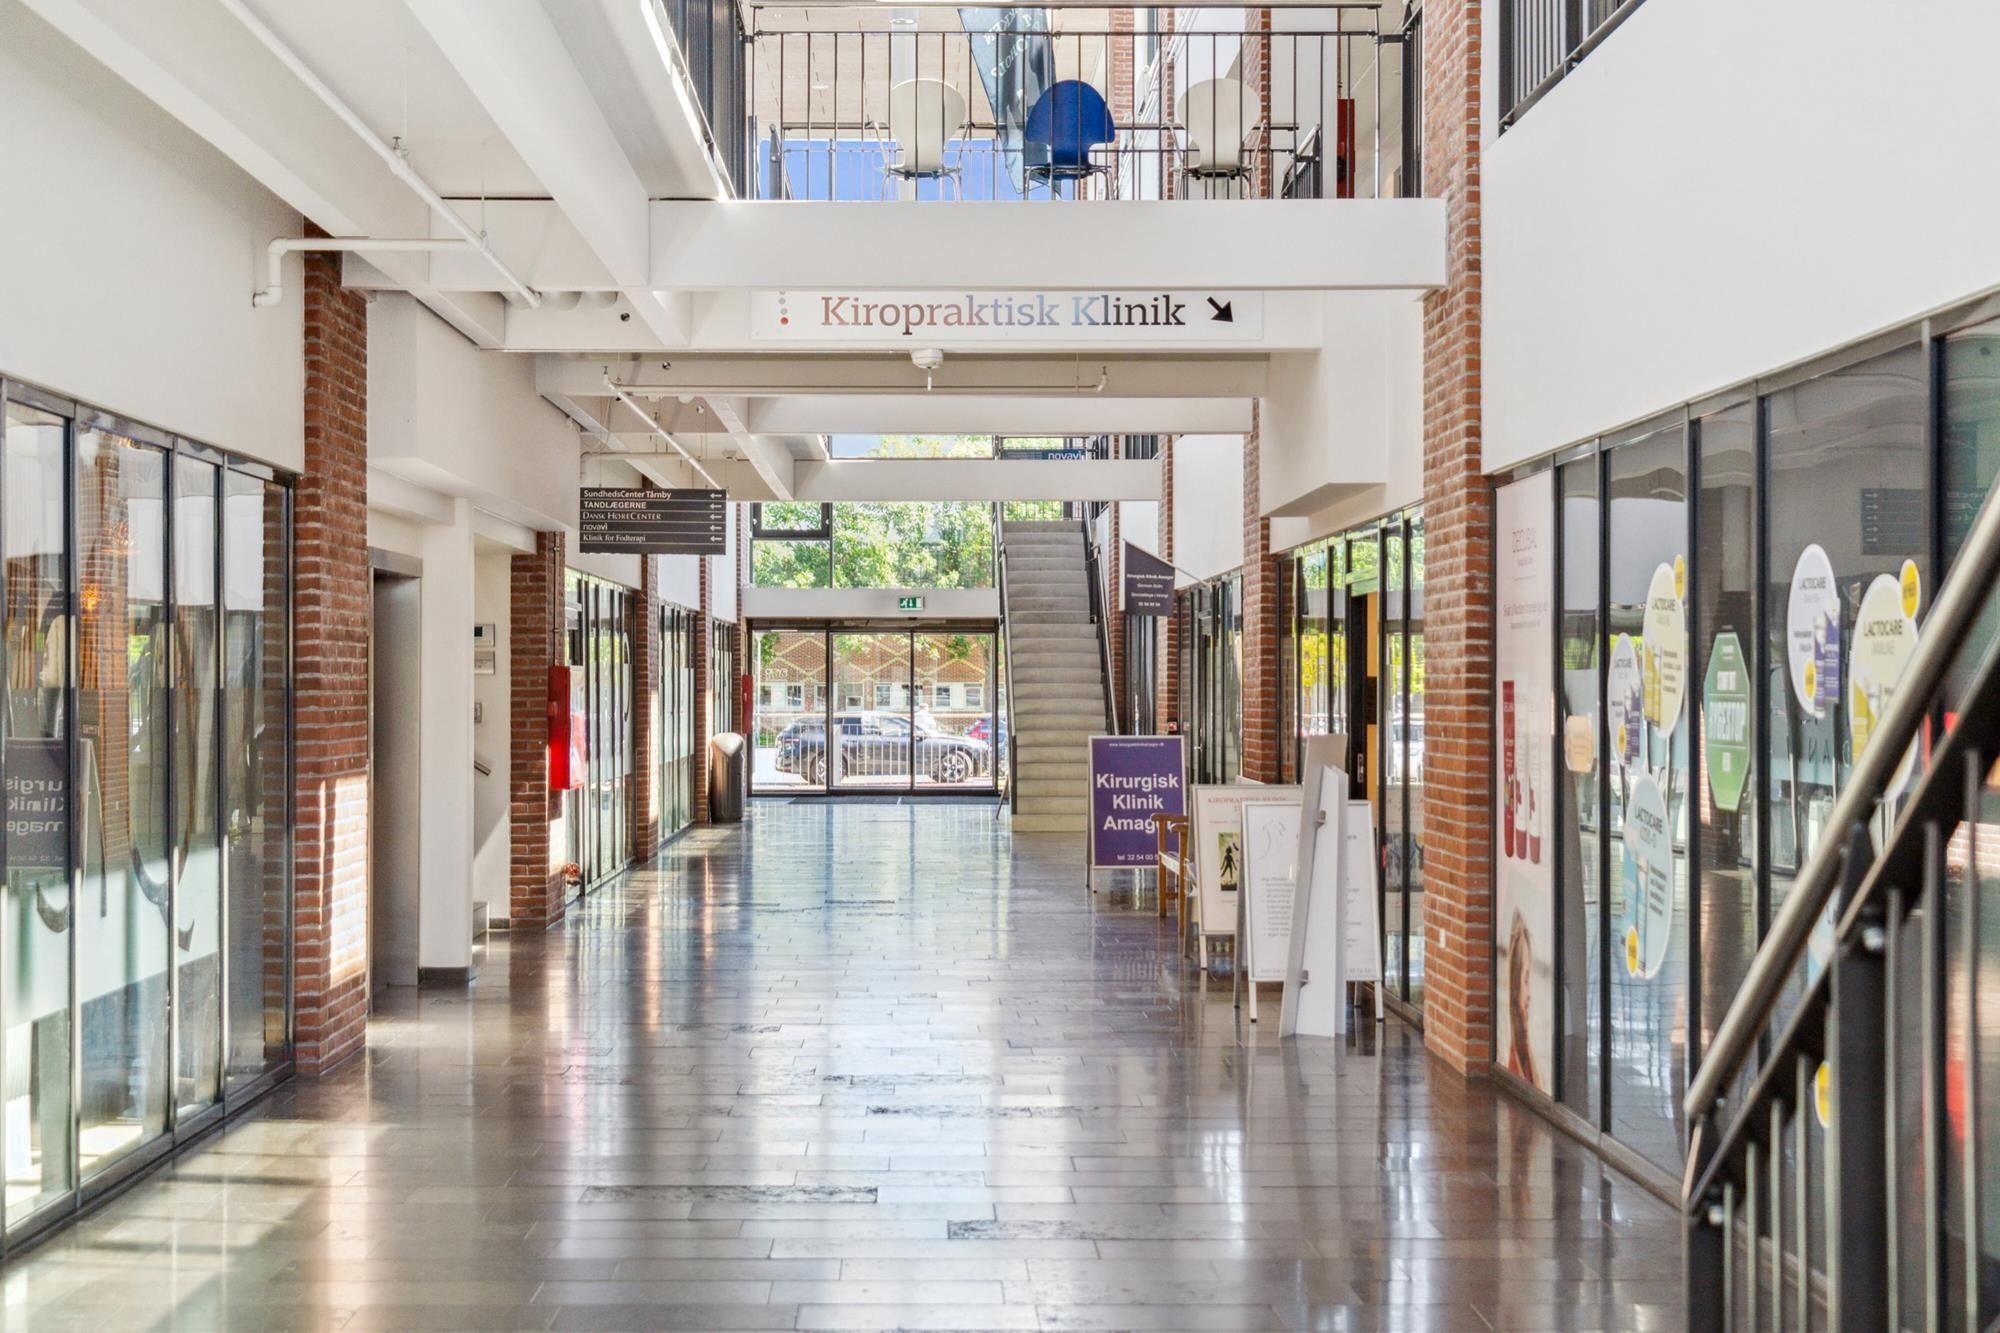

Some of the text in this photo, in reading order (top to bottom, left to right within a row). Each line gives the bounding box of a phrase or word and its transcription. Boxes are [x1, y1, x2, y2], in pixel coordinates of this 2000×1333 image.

[821, 294, 1186, 335] Kiropraktisk Klinik
[645, 489, 672, 500] Tårnby
[584, 501, 647, 510] TANDLÆGERNE
[583, 533, 603, 541] Klinik
[1863, 619, 1904, 637] LACTOCARE
[1096, 773, 1179, 791] Kirurgisk
[1113, 794, 1164, 810] Klinik
